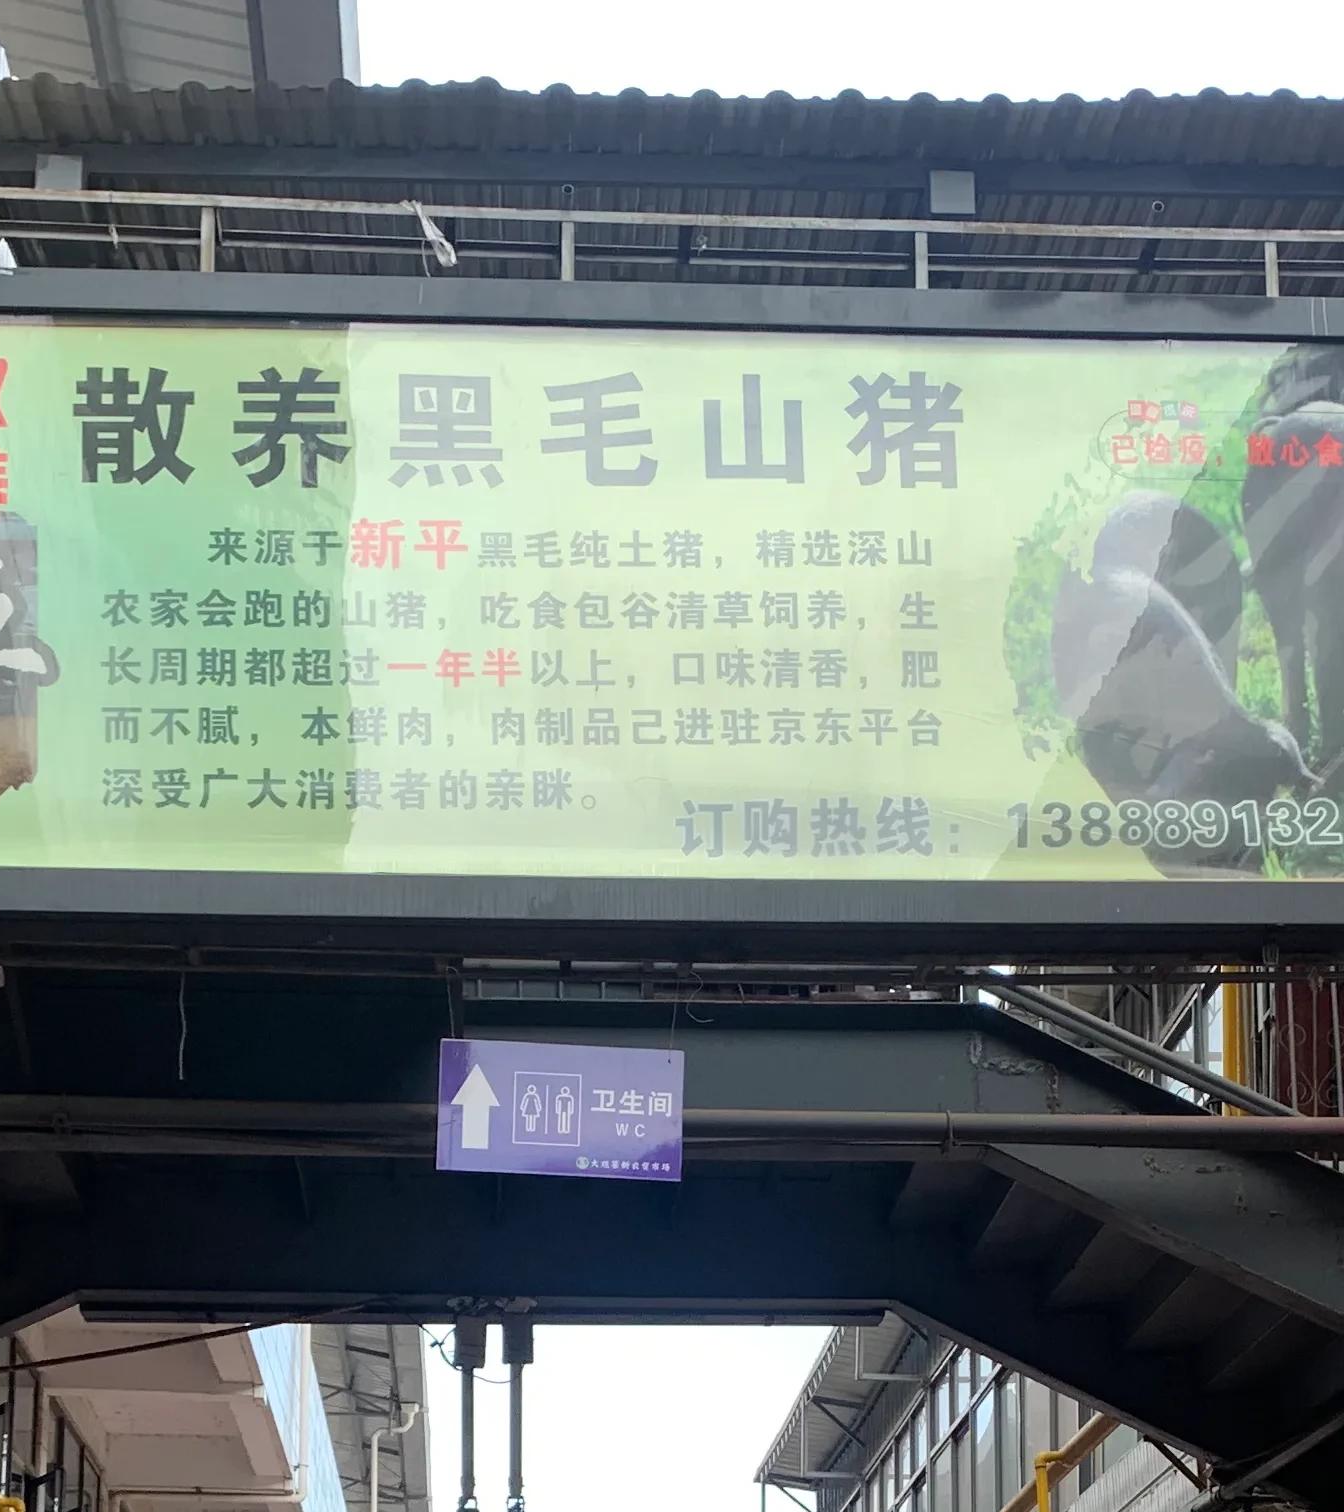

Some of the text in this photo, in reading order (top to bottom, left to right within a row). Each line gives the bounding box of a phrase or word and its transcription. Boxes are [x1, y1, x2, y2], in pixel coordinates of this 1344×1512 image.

[72, 366, 964, 488] 散养黑毛山猪
[207, 518, 936, 572] 来源于新平黑毛纯土猪，精选深山
[100, 588, 941, 631] 农家会跑的山猪，吃食包谷清草饲养，生
[100, 645, 942, 691] 长周期都超过一年半以上，口味清香，肥
[590, 1088, 674, 1118] 卫生间
